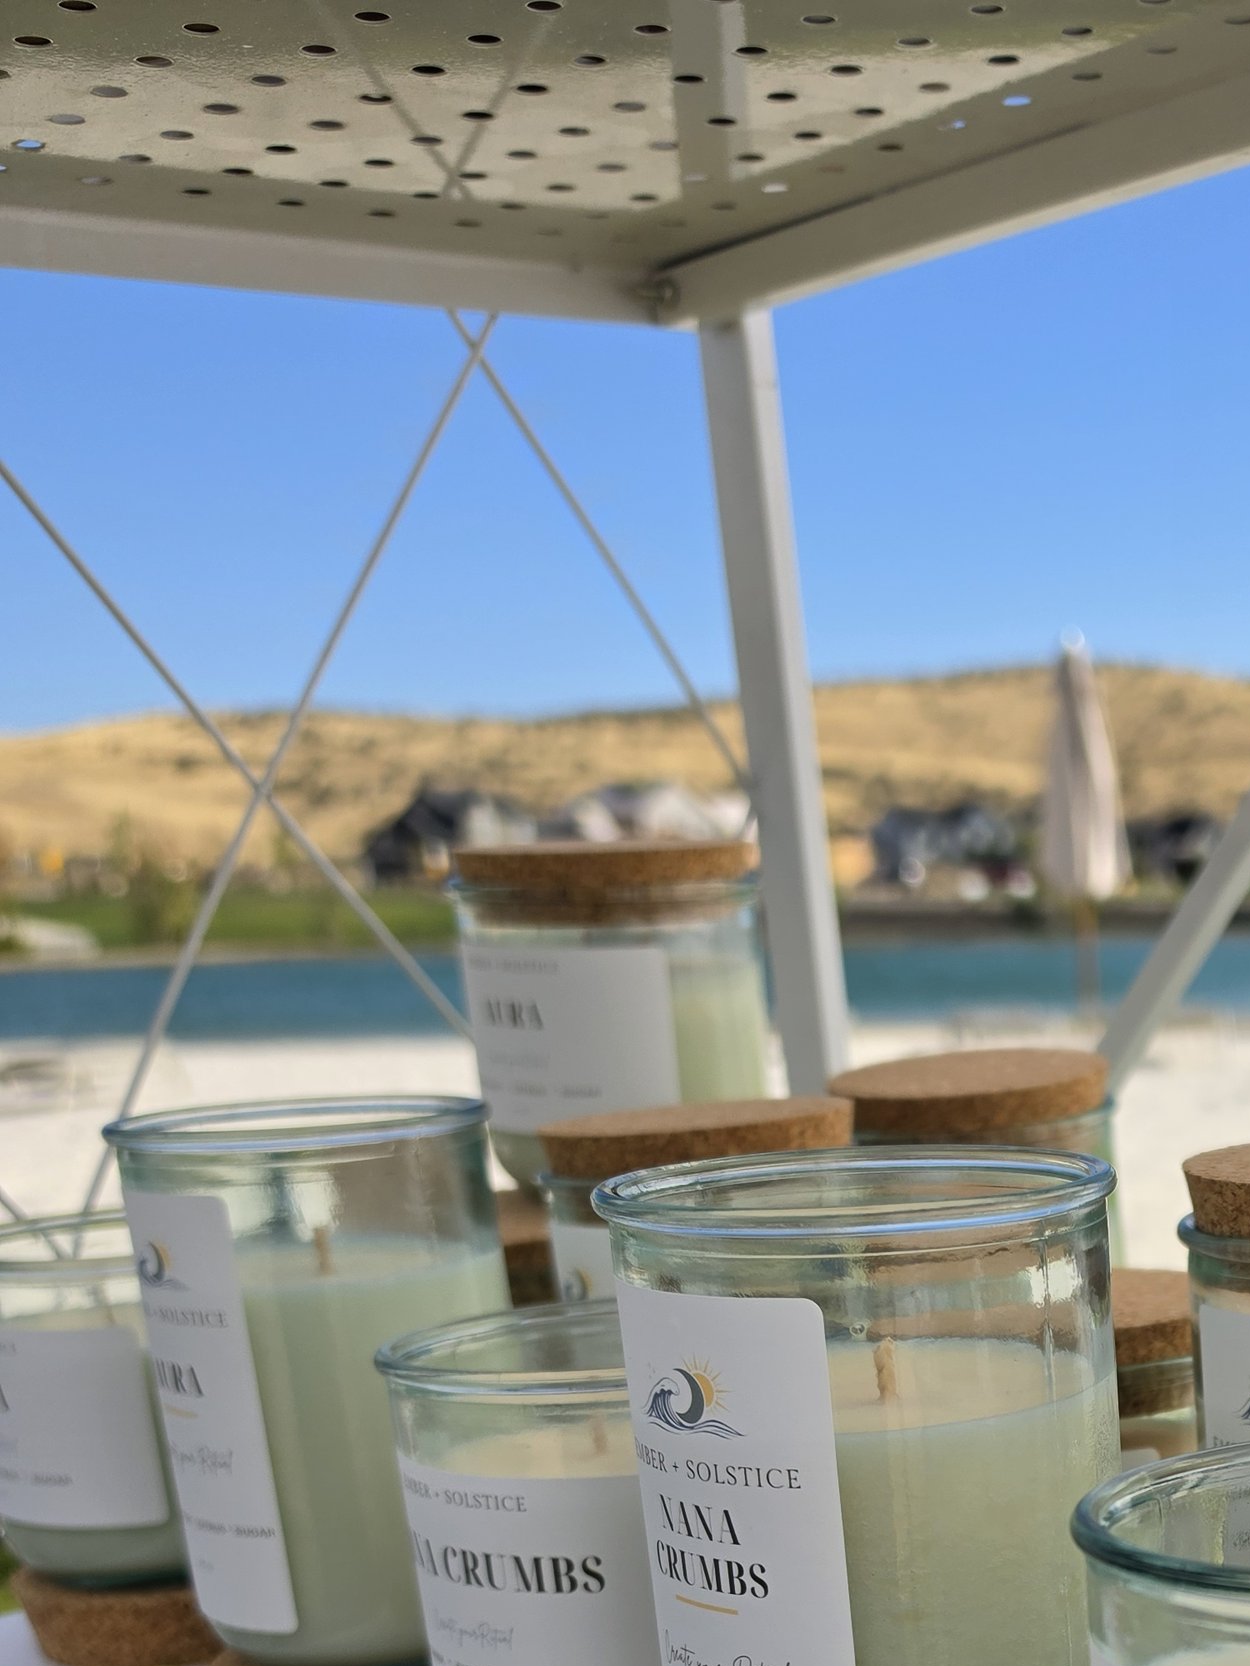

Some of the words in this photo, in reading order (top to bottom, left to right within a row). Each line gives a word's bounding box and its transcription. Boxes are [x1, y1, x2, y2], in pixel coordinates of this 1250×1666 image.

[684, 1458, 802, 1490] SOLSTICE
[444, 1488, 528, 1514] SOLSTICE
[658, 1493, 742, 1546] NANA
[442, 1545, 606, 1594] CRUMBS
[656, 1539, 770, 1600] CRUMBS
